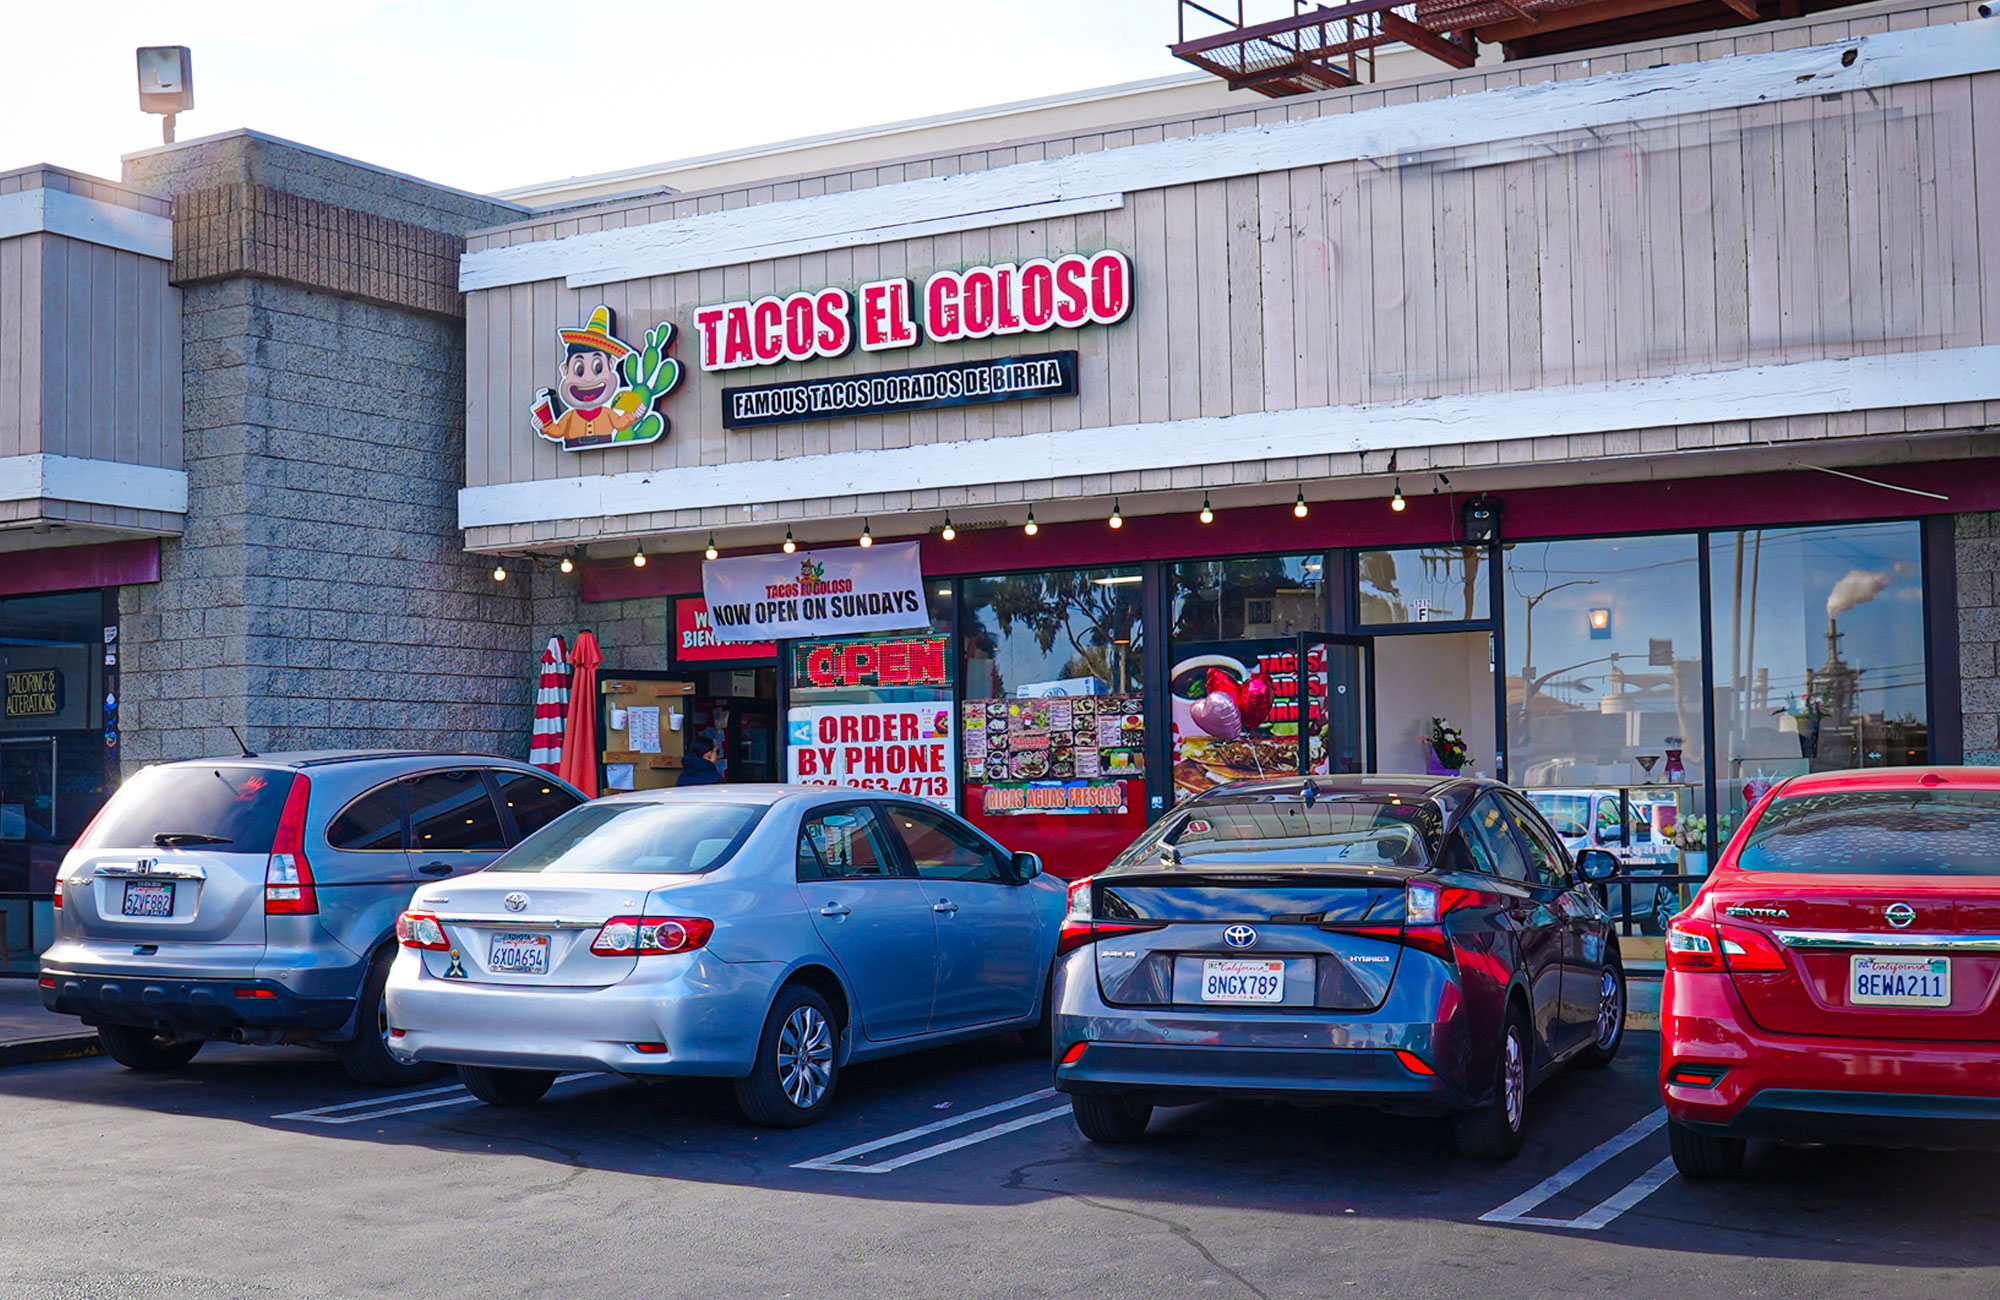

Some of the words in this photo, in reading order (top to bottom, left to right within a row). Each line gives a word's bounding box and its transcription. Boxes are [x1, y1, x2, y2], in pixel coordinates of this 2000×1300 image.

[698, 291, 850, 367] TACOS
[865, 282, 911, 345] EL
[928, 254, 1124, 338] GOLOSO
[734, 387, 806, 419] FAMOUS
[809, 379, 869, 411] TACOS
[872, 371, 962, 404] DORADOS
[963, 368, 990, 395] DE
[992, 359, 1063, 392] BIRRIA
[765, 584, 798, 599] TACOS
[801, 581, 812, 596] EL
[813, 578, 853, 594] GOLOSO
[713, 603, 751, 626] NOW
[755, 600, 798, 624] OPEN
[803, 597, 827, 620] ON
[831, 589, 919, 618] SUNDAYS
[1419, 608, 1426, 620] F
[808, 641, 947, 687] OPEN
[1256, 651, 1320, 672] TACS
[48, 672, 56, 692] &
[7, 693, 57, 714] ALTERATIONS
[819, 713, 919, 744] ORDER
[798, 748, 837, 776] BY
[845, 744, 945, 774] PHONE
[988, 789, 1025, 809] RICAS
[1027, 788, 1066, 808] AGUAS
[1069, 786, 1122, 807] FRESCAS
[1726, 906, 1791, 918] SENTRA
[1220, 962, 1268, 974] California
[1872, 962, 1932, 973] California
[1208, 975, 1278, 995] 8NGX789
[1858, 974, 1944, 997] 8EWA211
